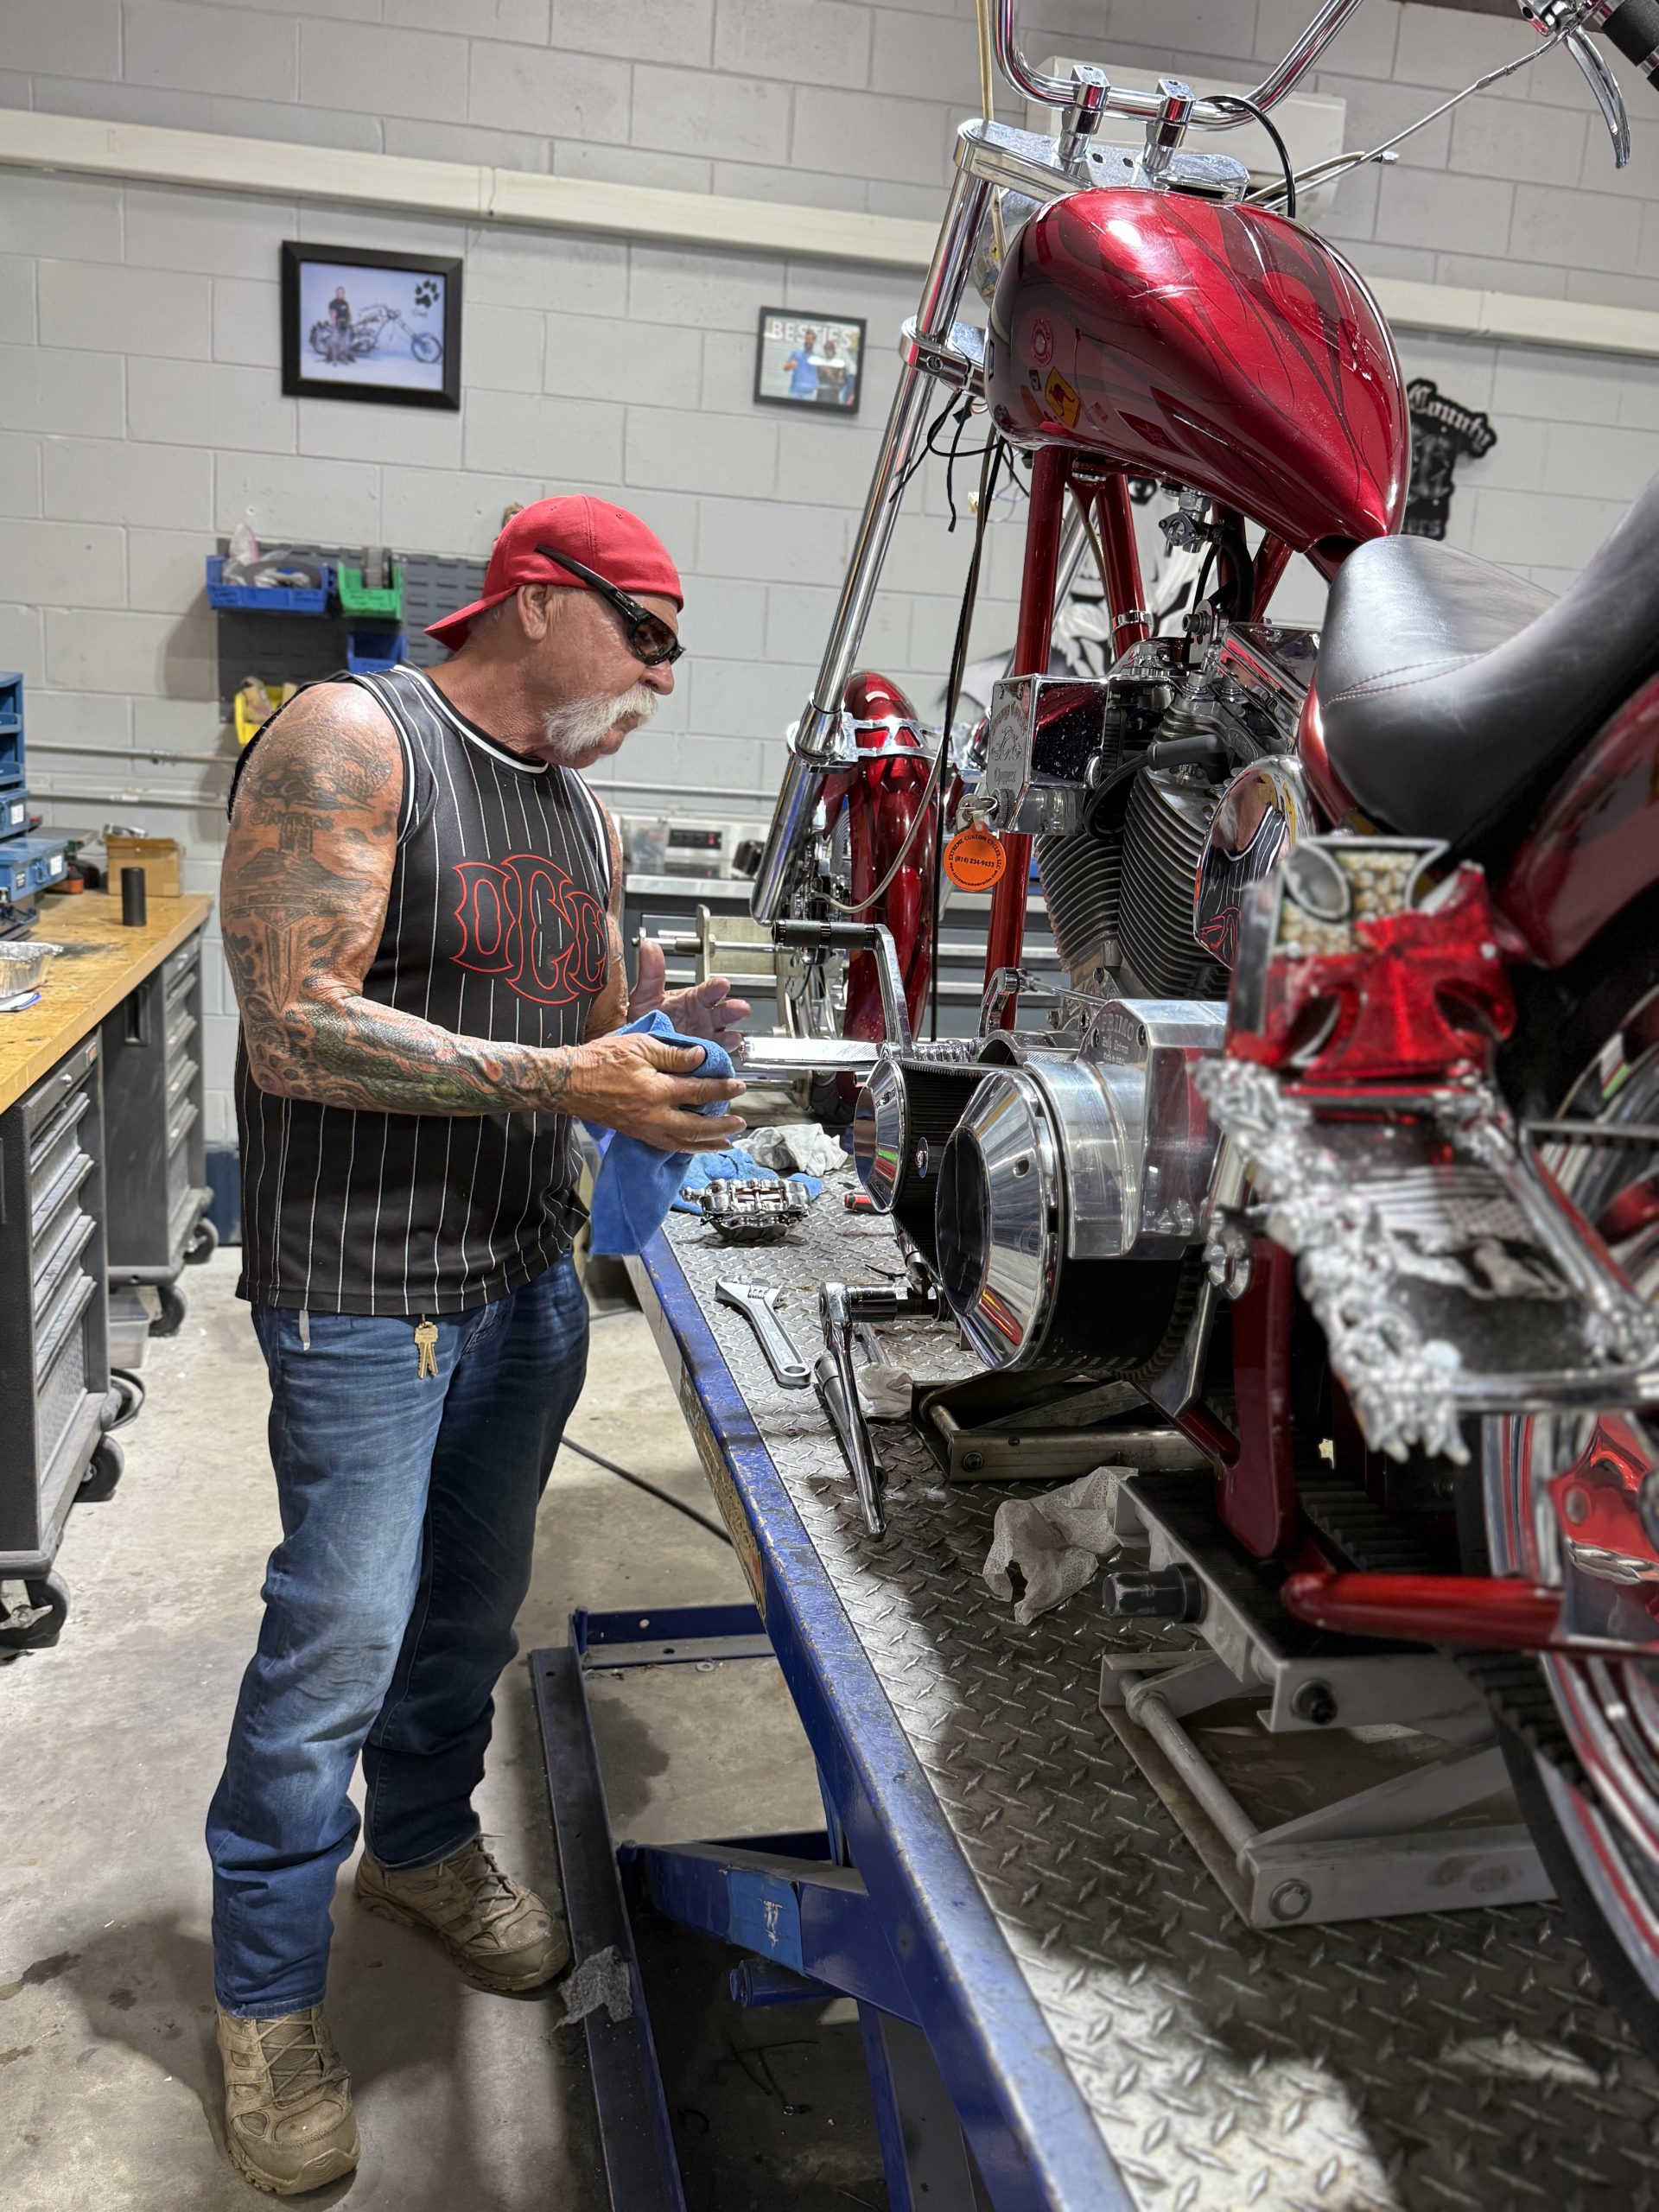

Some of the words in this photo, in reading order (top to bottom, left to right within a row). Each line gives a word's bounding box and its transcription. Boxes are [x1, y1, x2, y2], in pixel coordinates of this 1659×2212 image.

[772, 321, 852, 348] BESTIES
[1408, 385, 1491, 452] County
[949, 838, 964, 861] EXTREME
[987, 838, 1001, 858] CYCLES,
[955, 855, 969, 865] (814)
[969, 858, 995, 868] 234-9433
[1101, 1013, 1134, 1041] PRIMO
